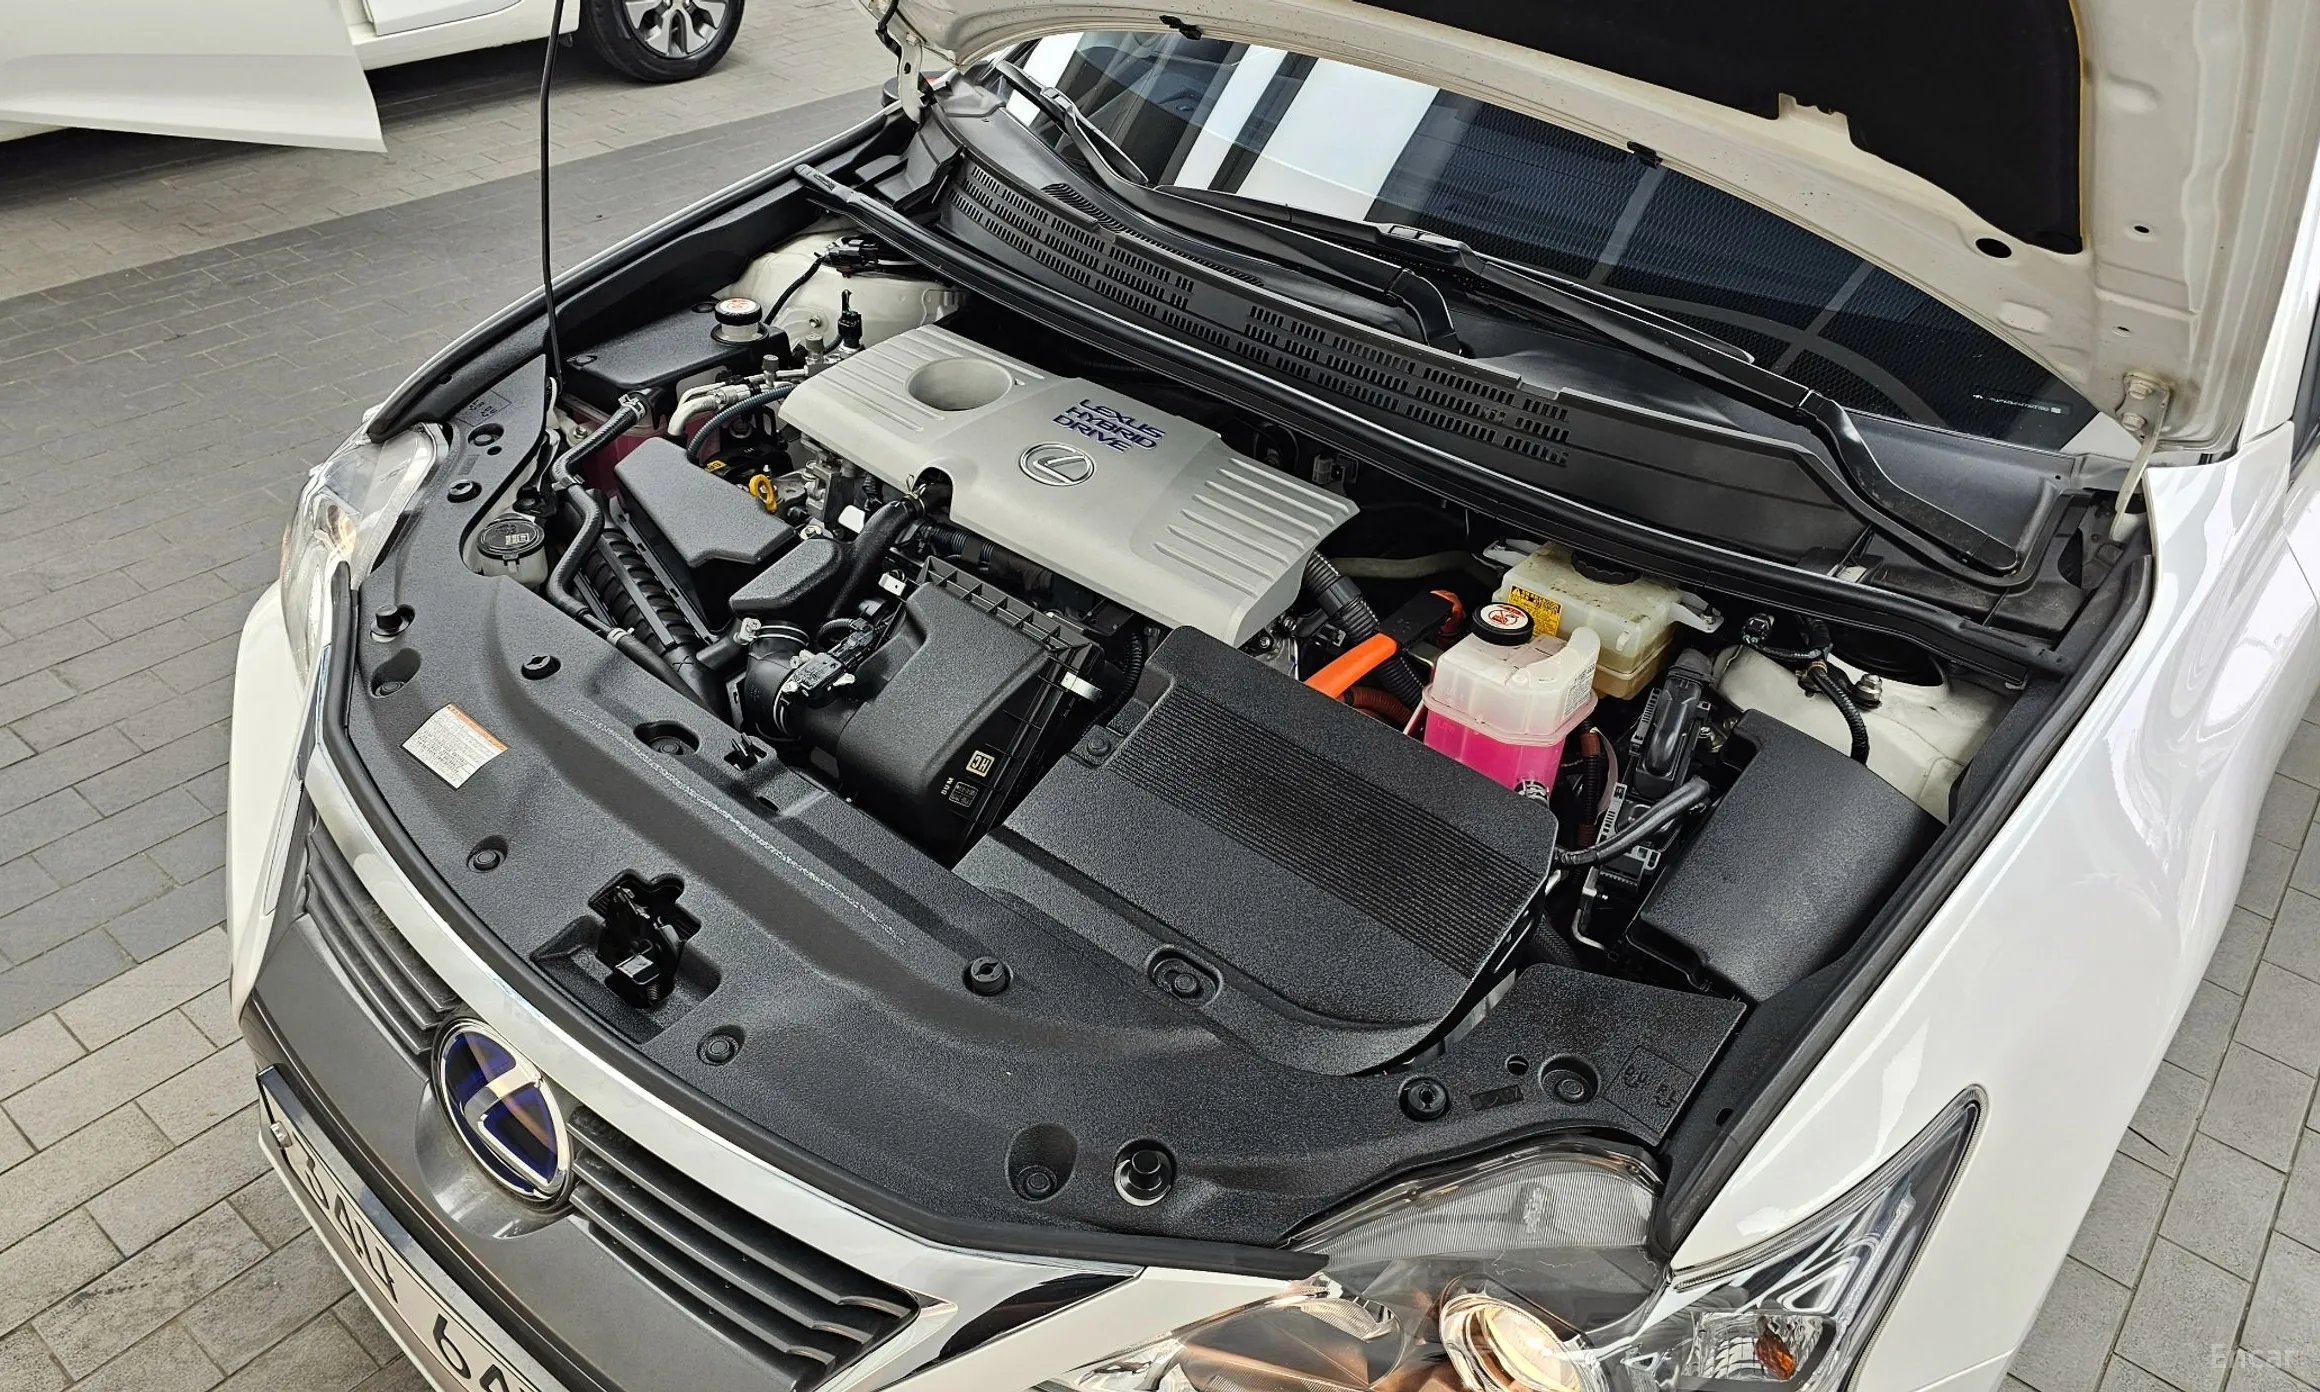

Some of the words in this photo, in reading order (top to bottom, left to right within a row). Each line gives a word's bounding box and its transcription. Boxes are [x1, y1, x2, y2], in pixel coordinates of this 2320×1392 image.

[1052, 415, 1132, 453] DRIVE
[1065, 406, 1157, 449] HYBRID
[1079, 399, 1166, 440] LEXUS
